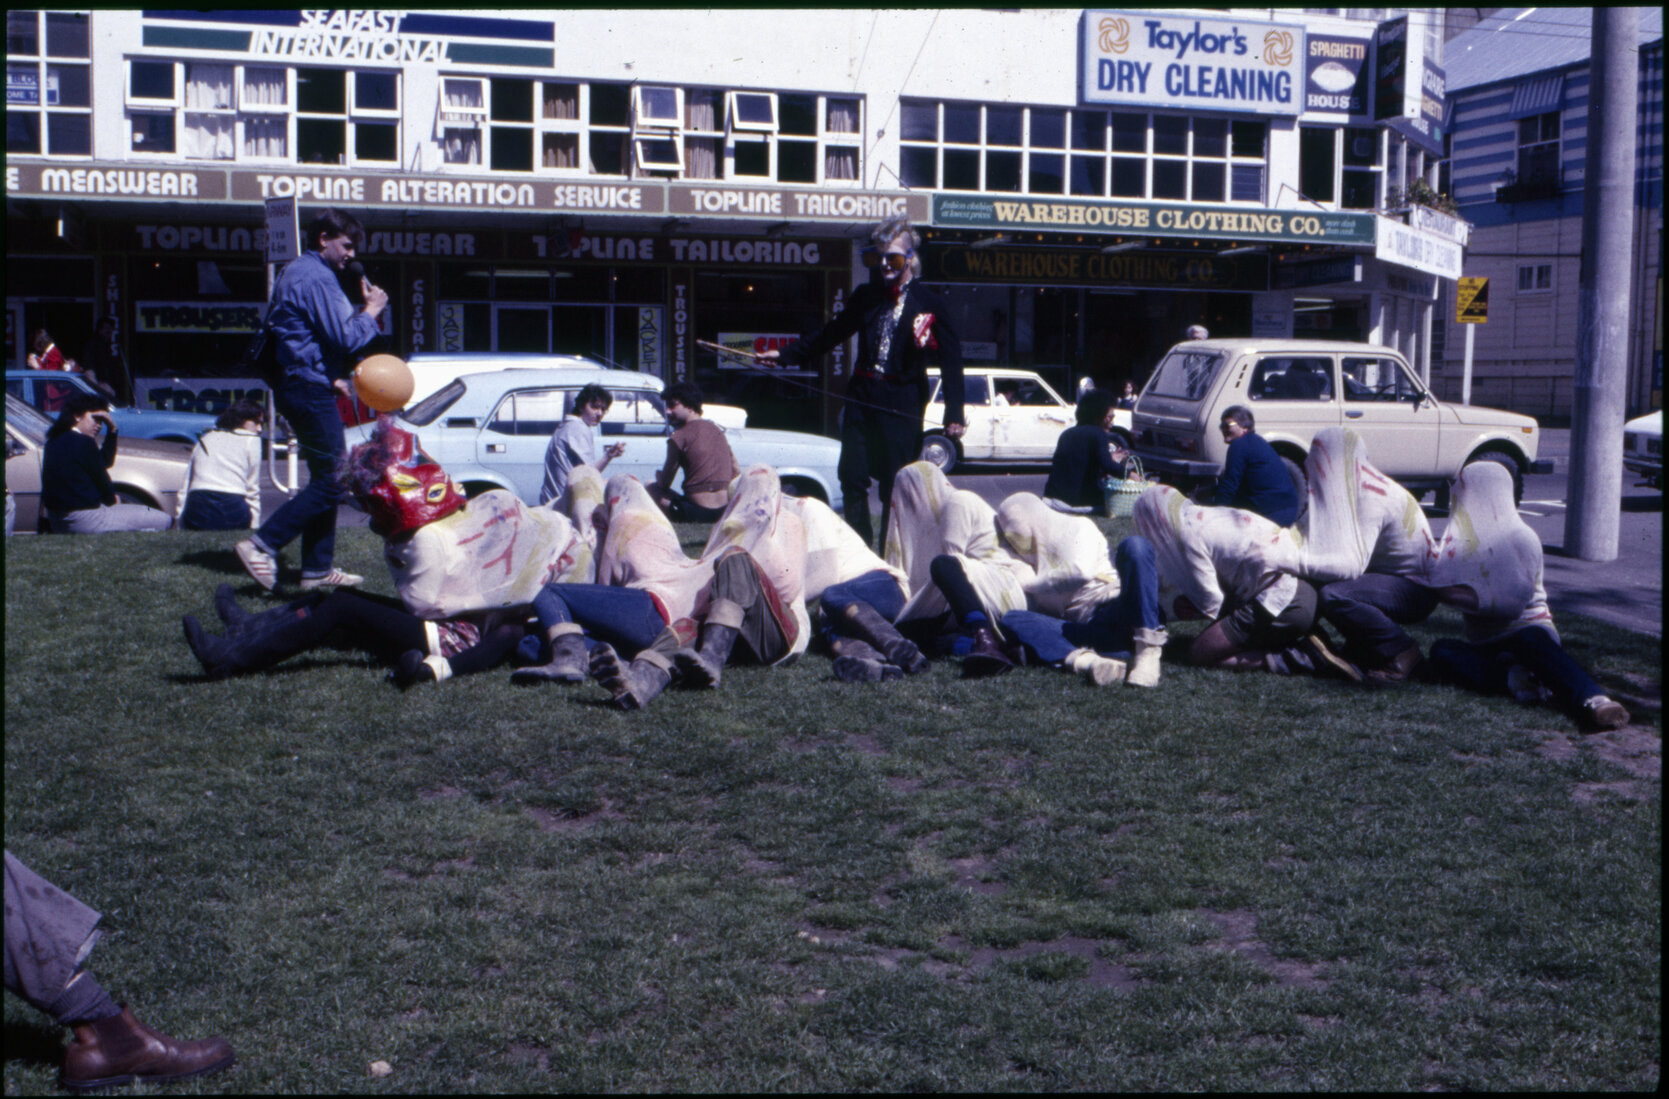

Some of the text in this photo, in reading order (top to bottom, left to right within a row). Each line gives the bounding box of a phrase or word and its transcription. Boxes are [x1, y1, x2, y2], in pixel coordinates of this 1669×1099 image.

[298, 8, 406, 34] SEAFAST
[250, 30, 453, 63] INTERNATIONAL
[1144, 20, 1248, 59] Taylor's
[1310, 40, 1365, 61] SPAGHETTI
[1098, 58, 1292, 104] DRY CLEANING
[1307, 94, 1361, 112] HOUSE
[42, 168, 198, 196] MENSWEAR
[257, 174, 642, 210] TOPLINE ALTERATION SERVICE
[691, 189, 908, 217] TOPLINE TAILORING
[993, 201, 1325, 237] WAREHOUSE CLOTHING CO.
[136, 224, 266, 251] TOPLINE
[669, 238, 820, 264] TAILORING
[964, 250, 1081, 279] WAREHOUSE
[1087, 254, 1178, 281] CLOTHING
[141, 306, 262, 331] TROUSERS
[833, 288, 845, 376] JATS
